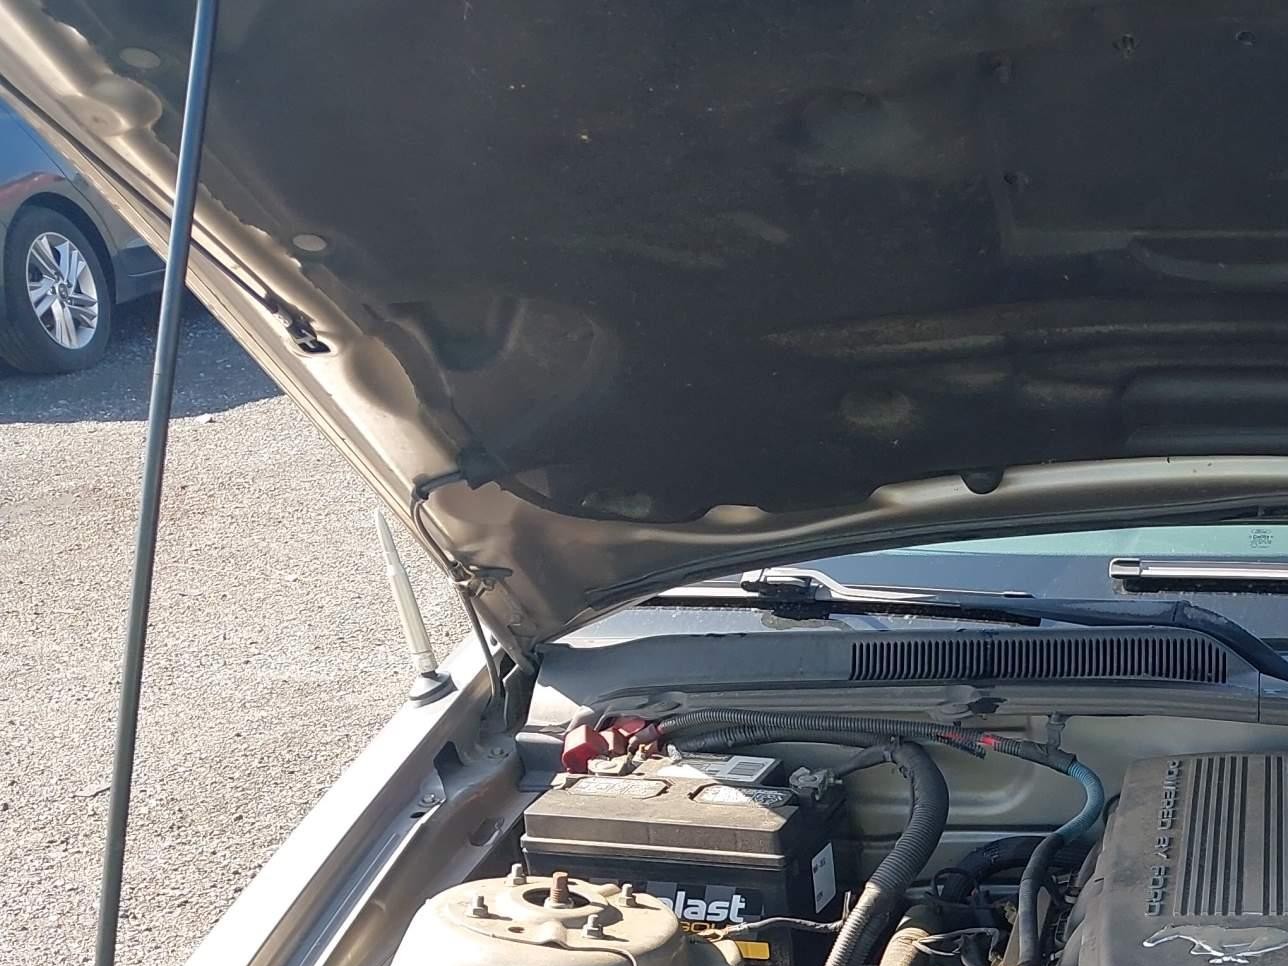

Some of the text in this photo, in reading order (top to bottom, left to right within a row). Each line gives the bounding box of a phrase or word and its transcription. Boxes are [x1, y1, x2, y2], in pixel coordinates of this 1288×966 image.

[1144, 759, 1182, 917] POWERED BY FORD
